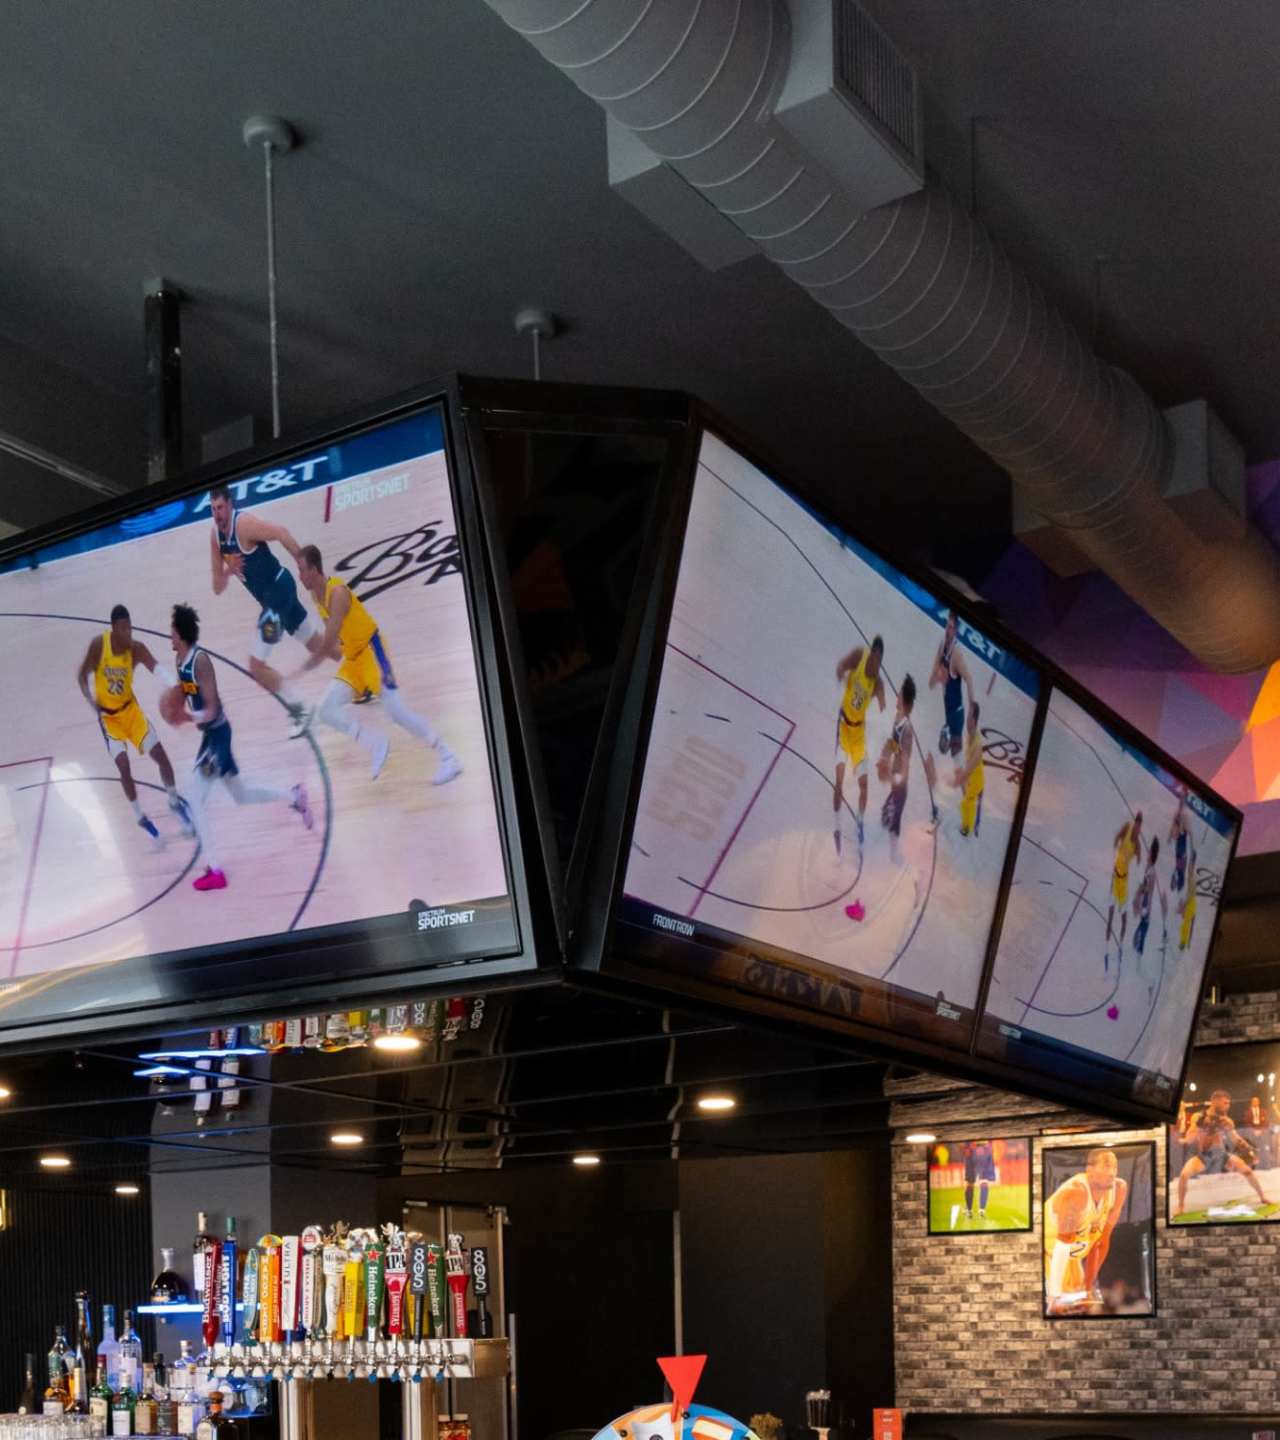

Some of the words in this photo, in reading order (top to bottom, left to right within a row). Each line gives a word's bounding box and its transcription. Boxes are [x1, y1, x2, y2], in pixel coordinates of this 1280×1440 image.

[418, 910, 475, 930] SPORTSNET
[202, 1255, 212, 1324] Budweiser
[367, 1265, 379, 1316] Heineken
[412, 1247, 425, 1289] 805
[472, 1249, 487, 1291] 805
[427, 1268, 440, 1316] Heineken
